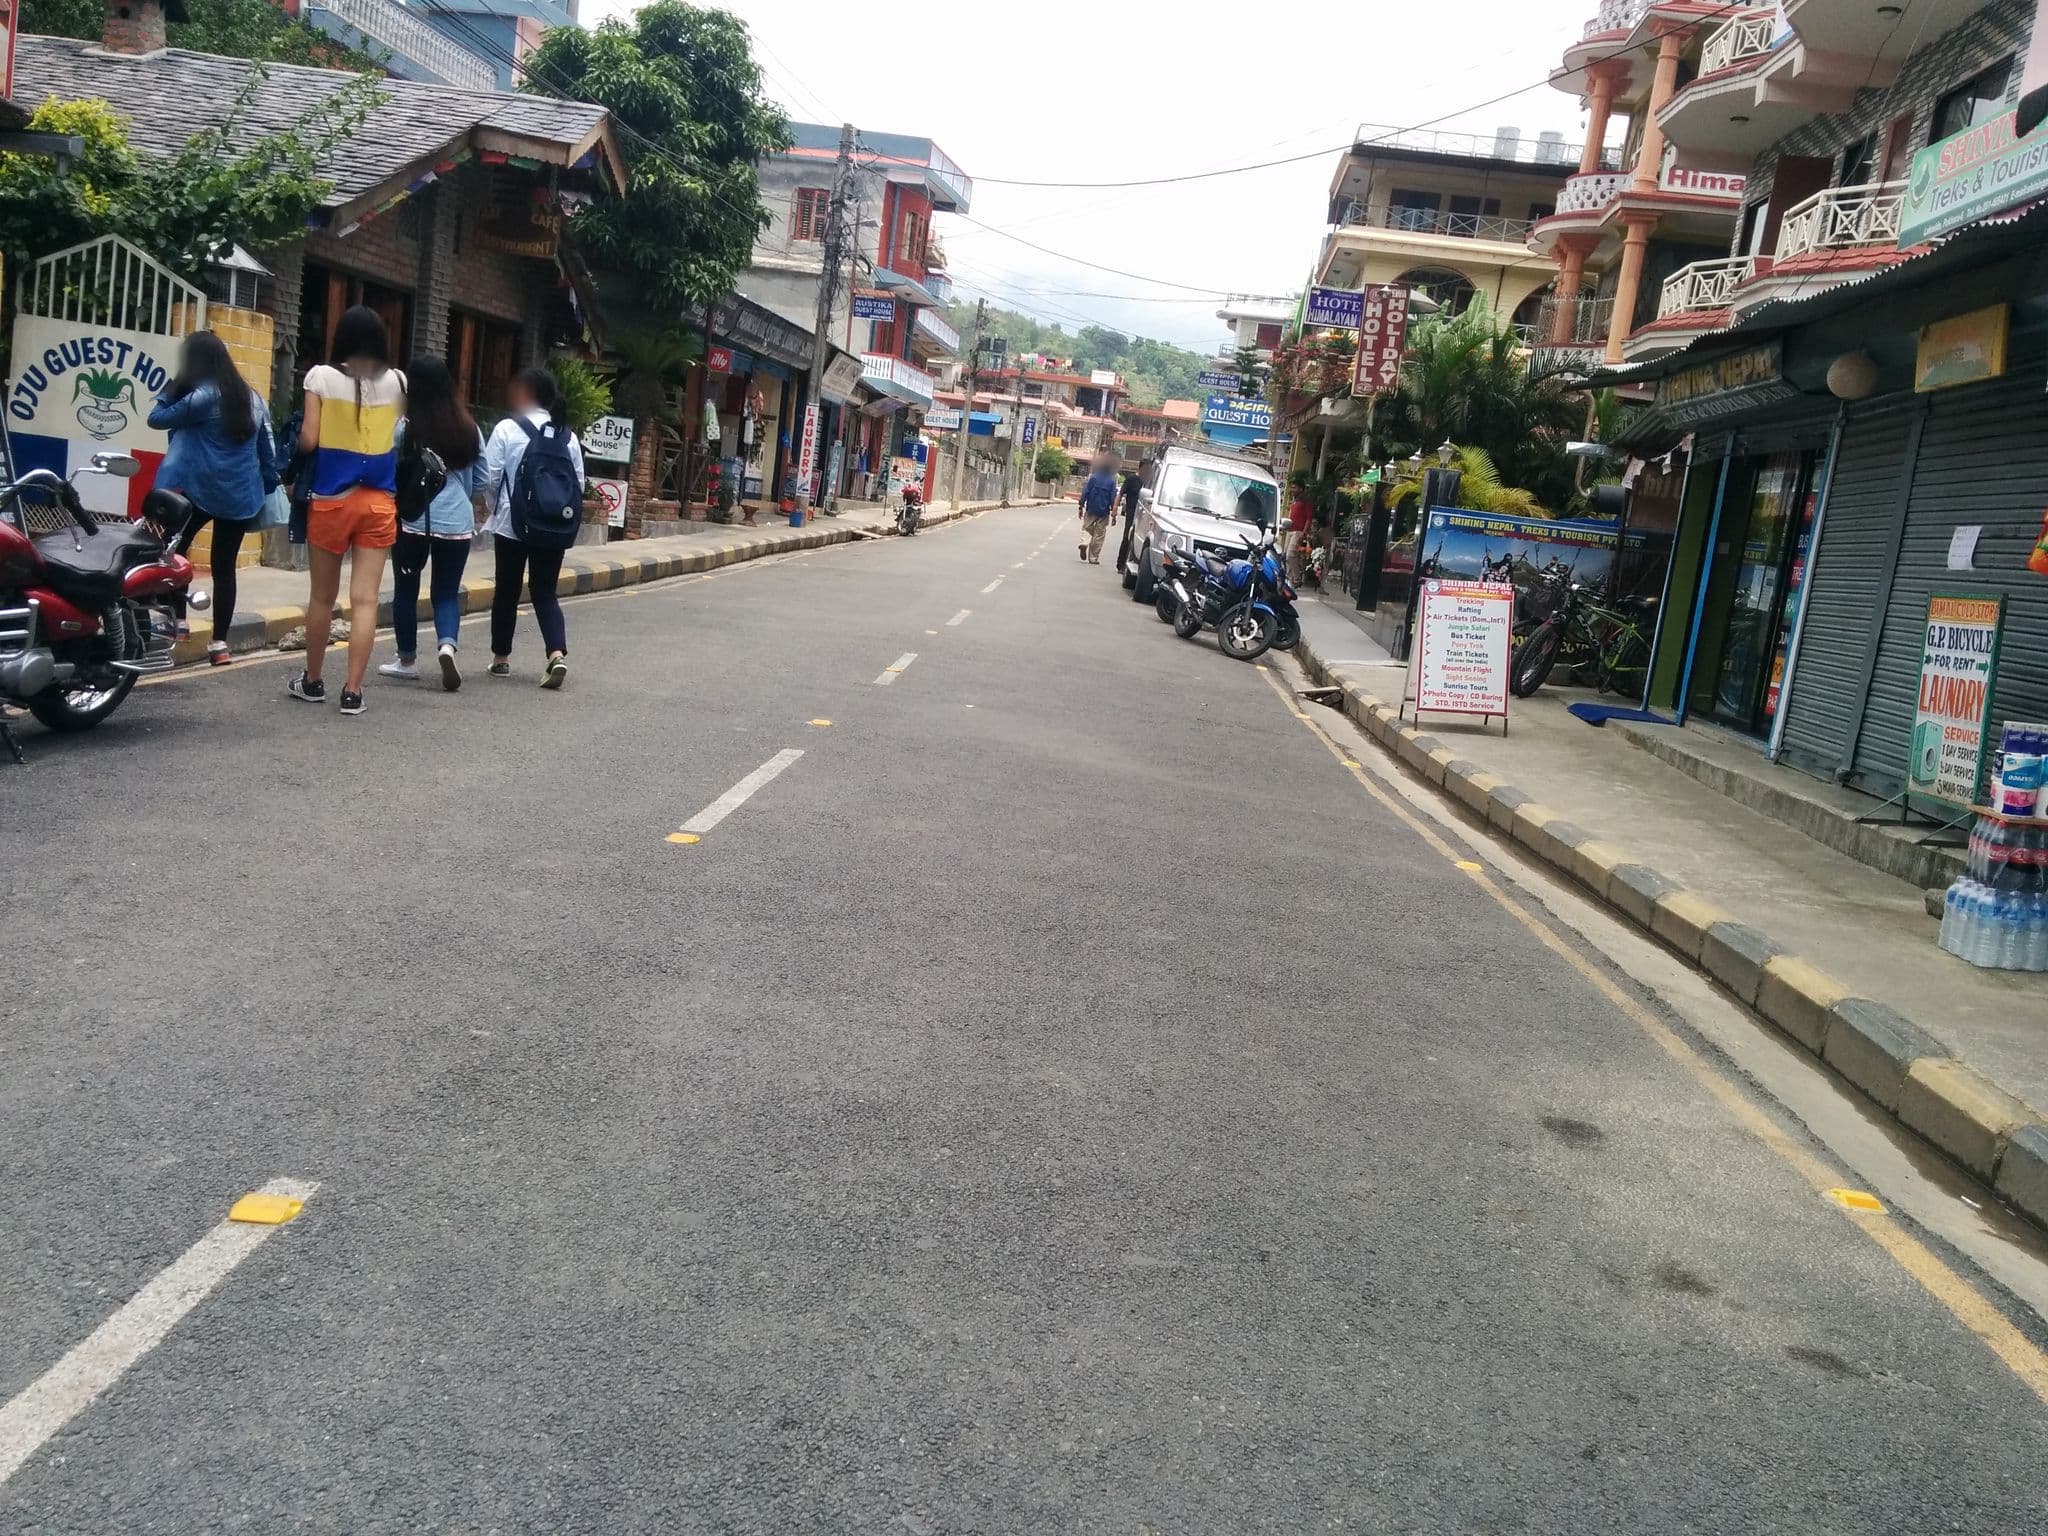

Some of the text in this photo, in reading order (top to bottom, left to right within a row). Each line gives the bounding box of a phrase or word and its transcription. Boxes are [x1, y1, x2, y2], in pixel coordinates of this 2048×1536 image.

[1930, 177, 1969, 214] Treks
[1972, 166, 1984, 194] &
[874, 308, 892, 316] HOUSE
[1316, 296, 1361, 313] HOTE
[1360, 302, 1383, 383] HOTEL
[1379, 298, 1406, 385] HOLIDAY
[710, 352, 728, 367] illy
[9, 364, 48, 421] OJU
[43, 337, 133, 376] GUEST
[1199, 377, 1238, 387] GUEST HOUSE
[1205, 372, 1235, 380] PACIFIC
[1229, 399, 1276, 414] PACIFIC
[925, 415, 958, 425] GUEST HOUSE
[1208, 408, 1249, 423] GUEST
[605, 419, 632, 441] Eye
[800, 407, 815, 478] LAUNDRY
[1448, 516, 1485, 529] SHINING
[1487, 521, 1515, 532] NEPAL
[1520, 525, 1549, 537] TREKS
[1551, 529, 1558, 537] &
[1561, 530, 1601, 543] TOURISM
[1441, 579, 1513, 591] SHINING NEPAL
[1456, 598, 1485, 607] Trekking
[1956, 602, 1976, 618] COLD
[1444, 614, 1468, 622] Tickets
[1458, 606, 1482, 615] Rafting
[1447, 623, 1470, 631] Jungle
[1947, 626, 1994, 654] BICYCLE
[1446, 649, 1463, 657] Train
[1441, 664, 1492, 675] Mountain Flight
[1934, 654, 1976, 672] FOR RENT
[1445, 673, 1463, 682] Sight
[1443, 682, 1468, 690] Sunrise
[1427, 690, 1447, 698] Photo
[1448, 691, 1465, 699] Copy
[1918, 673, 1988, 723] LAUNDRY
[1469, 701, 1495, 710] Service
[1943, 726, 1979, 746] SERVICE
[1941, 743, 1978, 764] 1 DAY SERVICE
[1945, 762, 1953, 775] DAY
[1954, 764, 1975, 781] SERVICE
[1956, 784, 1974, 798] SERVICE
